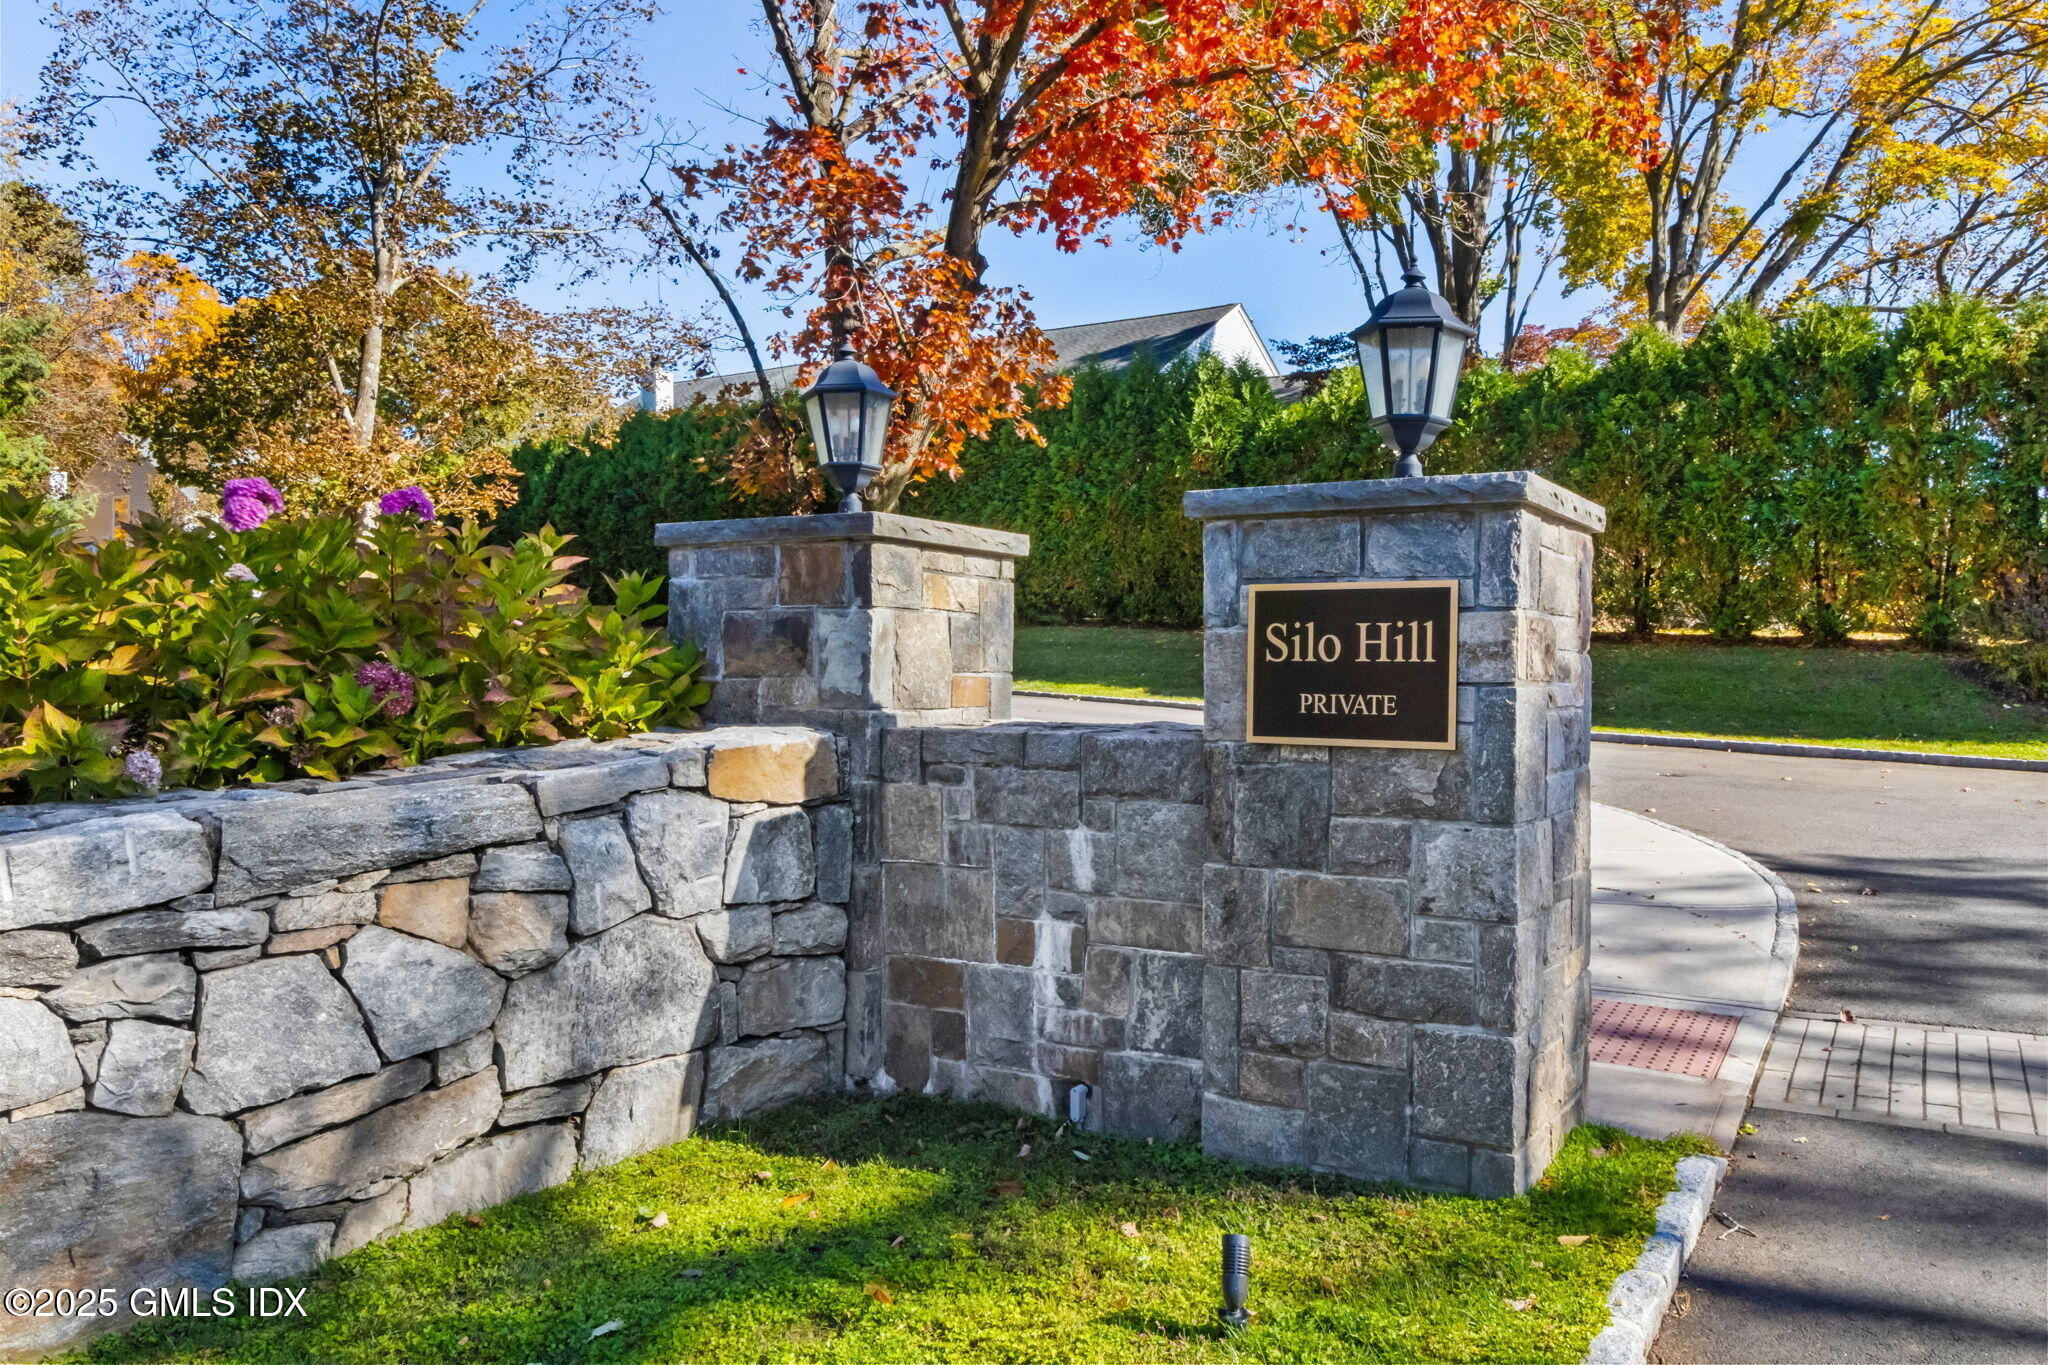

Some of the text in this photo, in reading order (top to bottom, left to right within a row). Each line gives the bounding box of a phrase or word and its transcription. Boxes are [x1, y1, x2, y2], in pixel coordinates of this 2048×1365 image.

[1265, 620, 1437, 663] Silo Hill
[1299, 693, 1398, 716] PRIVATE
